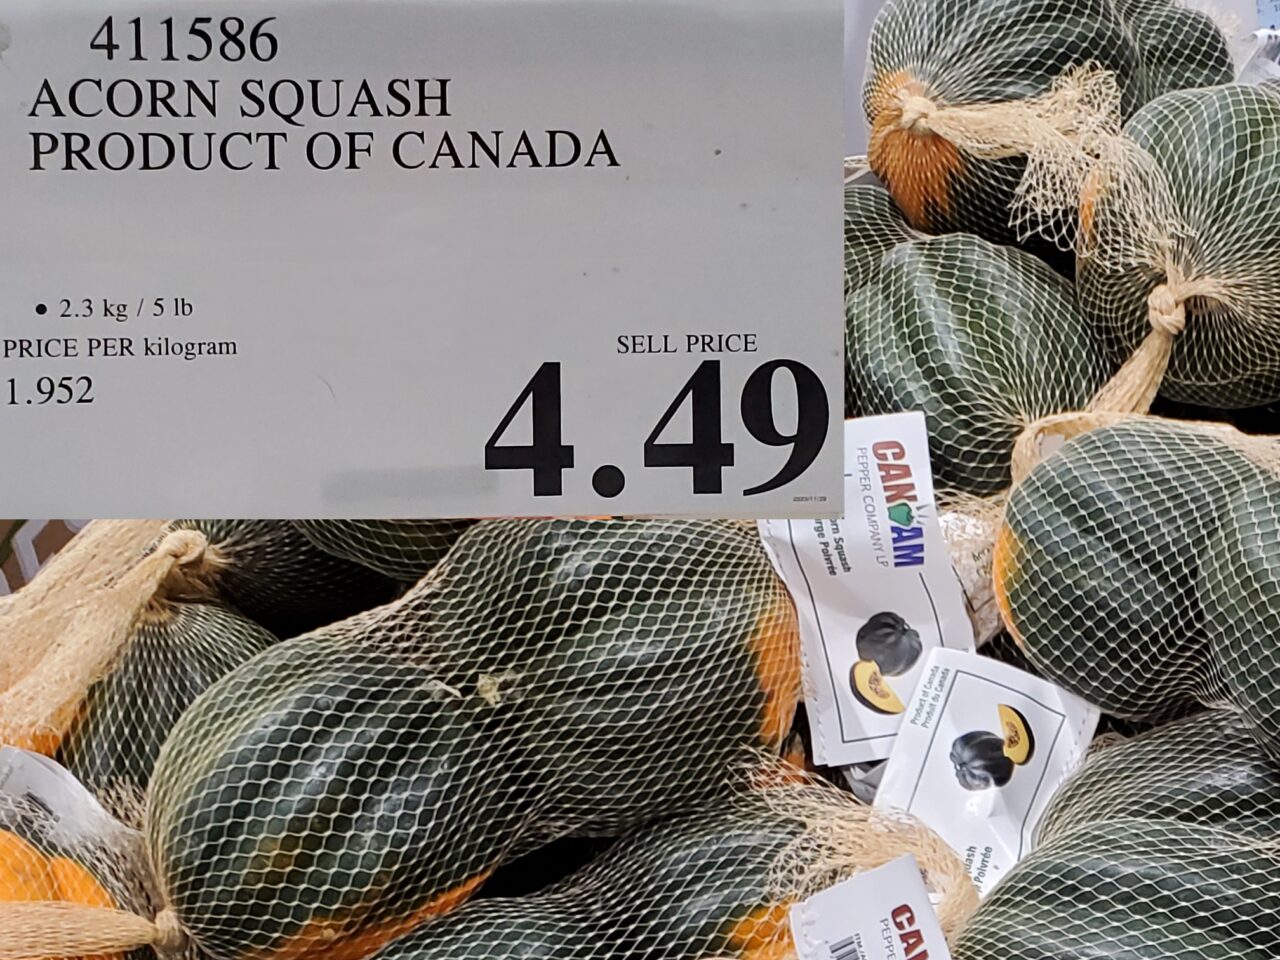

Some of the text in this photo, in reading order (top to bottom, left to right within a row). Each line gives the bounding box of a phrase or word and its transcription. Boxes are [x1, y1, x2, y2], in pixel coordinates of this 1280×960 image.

[90, 16, 279, 63] 411586
[28, 78, 452, 126] ACORN SQUASH
[29, 128, 621, 171] PRODUCT OF CANADA
[60, 298, 94, 318] 2.3
[103, 298, 128, 322] kg
[153, 297, 165, 317] 5
[174, 297, 193, 317] lb
[3, 336, 238, 361] PRICE PER kilogram
[617, 333, 758, 354] SELL PRICE
[7, 376, 95, 405] 1.952
[485, 359, 830, 500] 4.49
[857, 447, 889, 568] PEPPER COMPANY LP
[872, 440, 925, 568] CAN AM
[813, 518, 826, 538] urge
[829, 518, 852, 573] orn Squash
[910, 698, 927, 725] Product
[923, 665, 940, 690] Canada
[920, 703, 937, 729] Produit
[934, 667, 950, 693] Canada
[964, 846, 977, 873] uash
[973, 846, 993, 884] Poivrée
